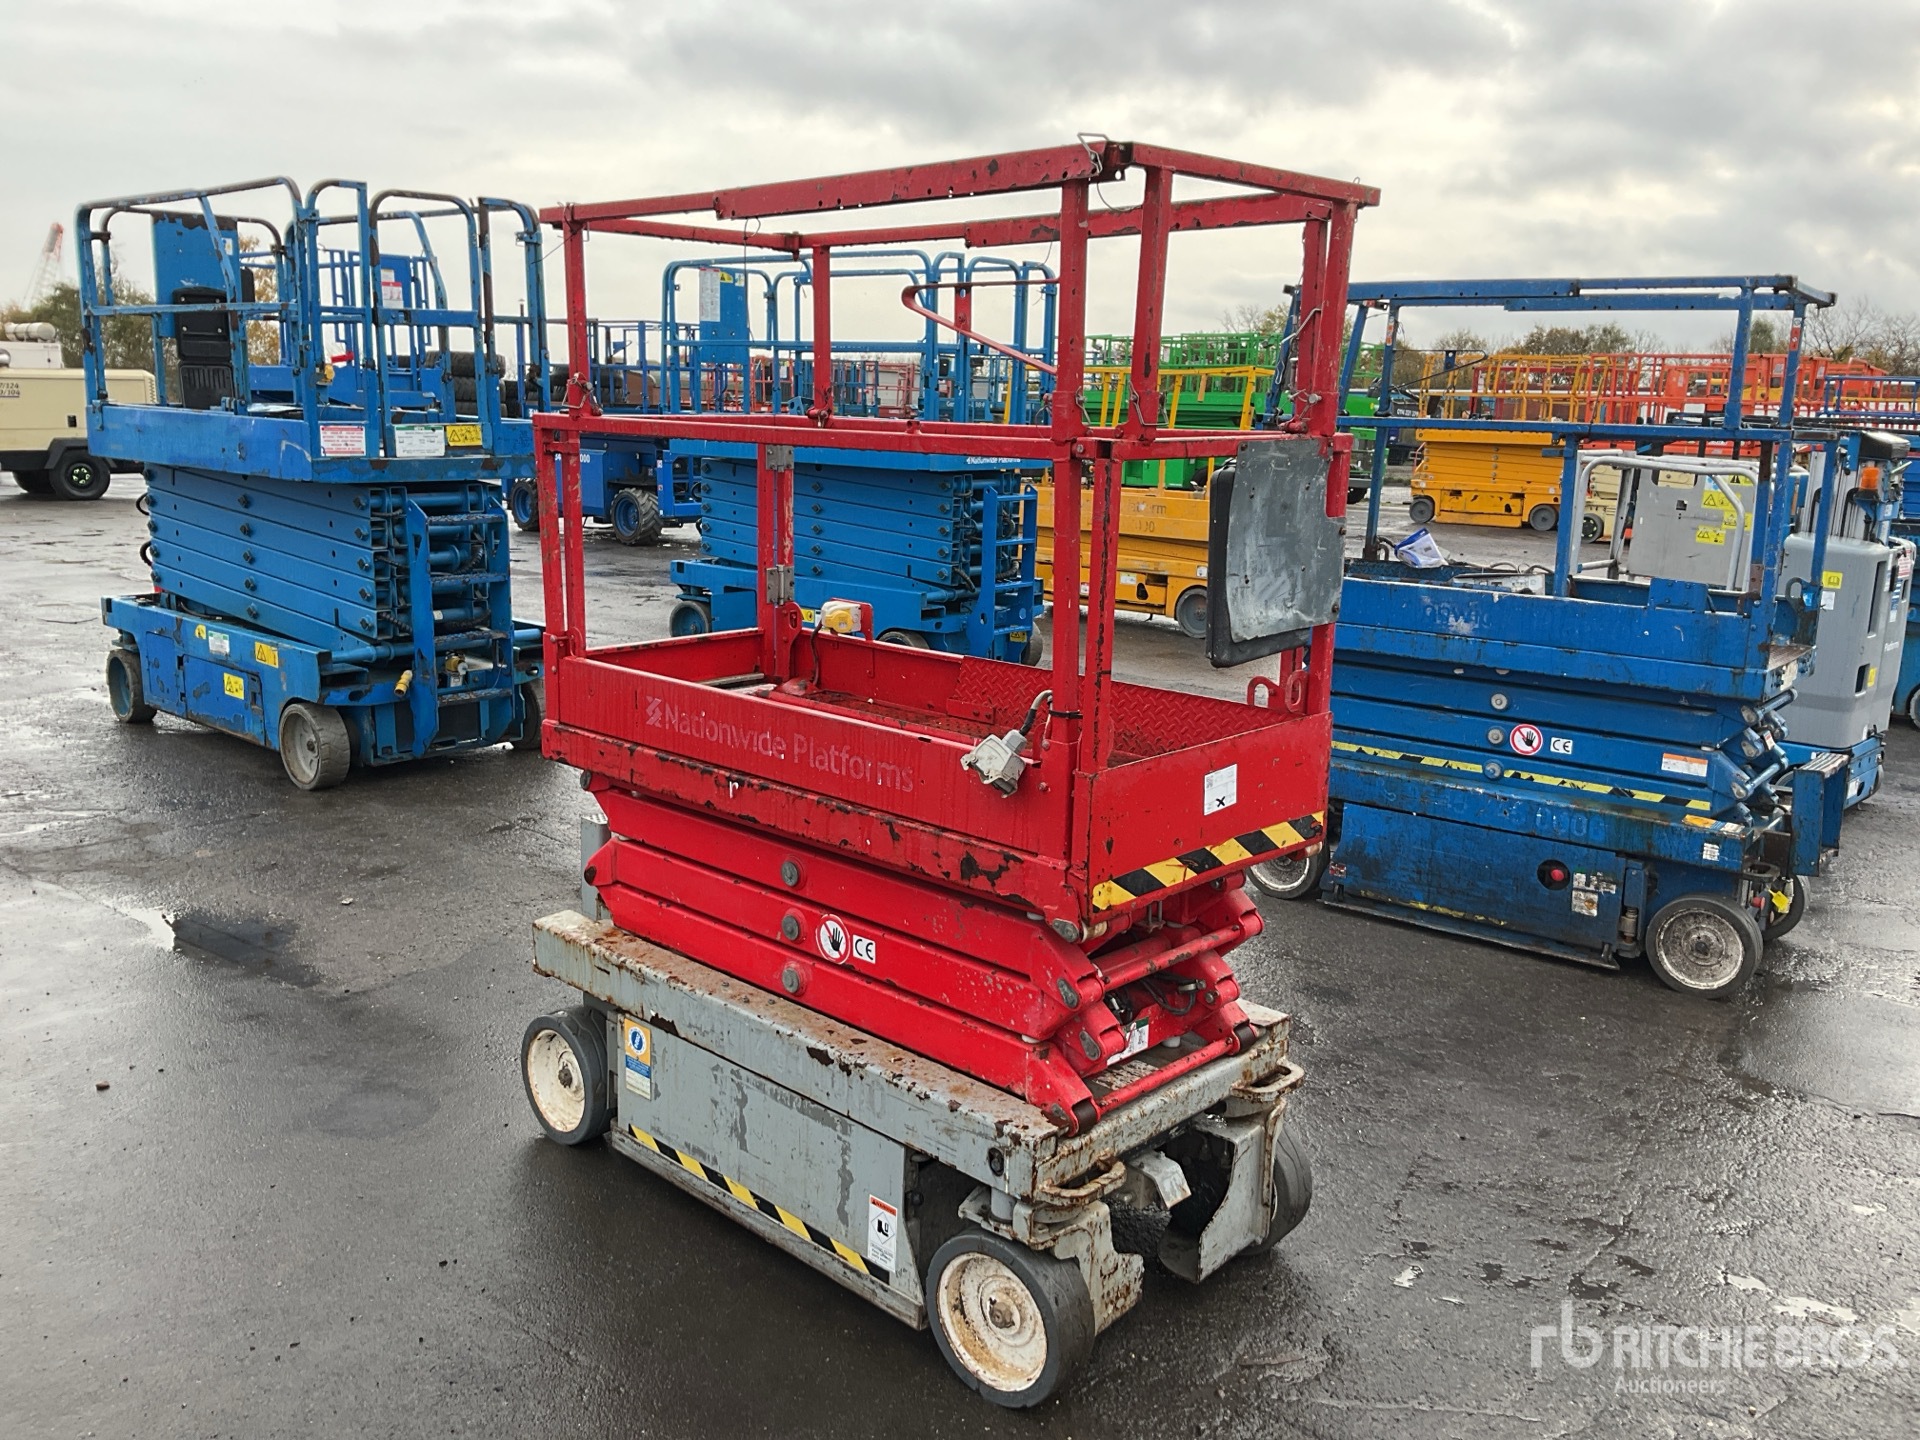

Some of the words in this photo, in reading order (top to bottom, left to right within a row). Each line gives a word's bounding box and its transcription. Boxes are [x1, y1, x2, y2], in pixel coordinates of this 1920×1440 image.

[665, 703, 785, 760] Nationwide
[792, 733, 914, 792] Platforms
[854, 938, 874, 961] CE
